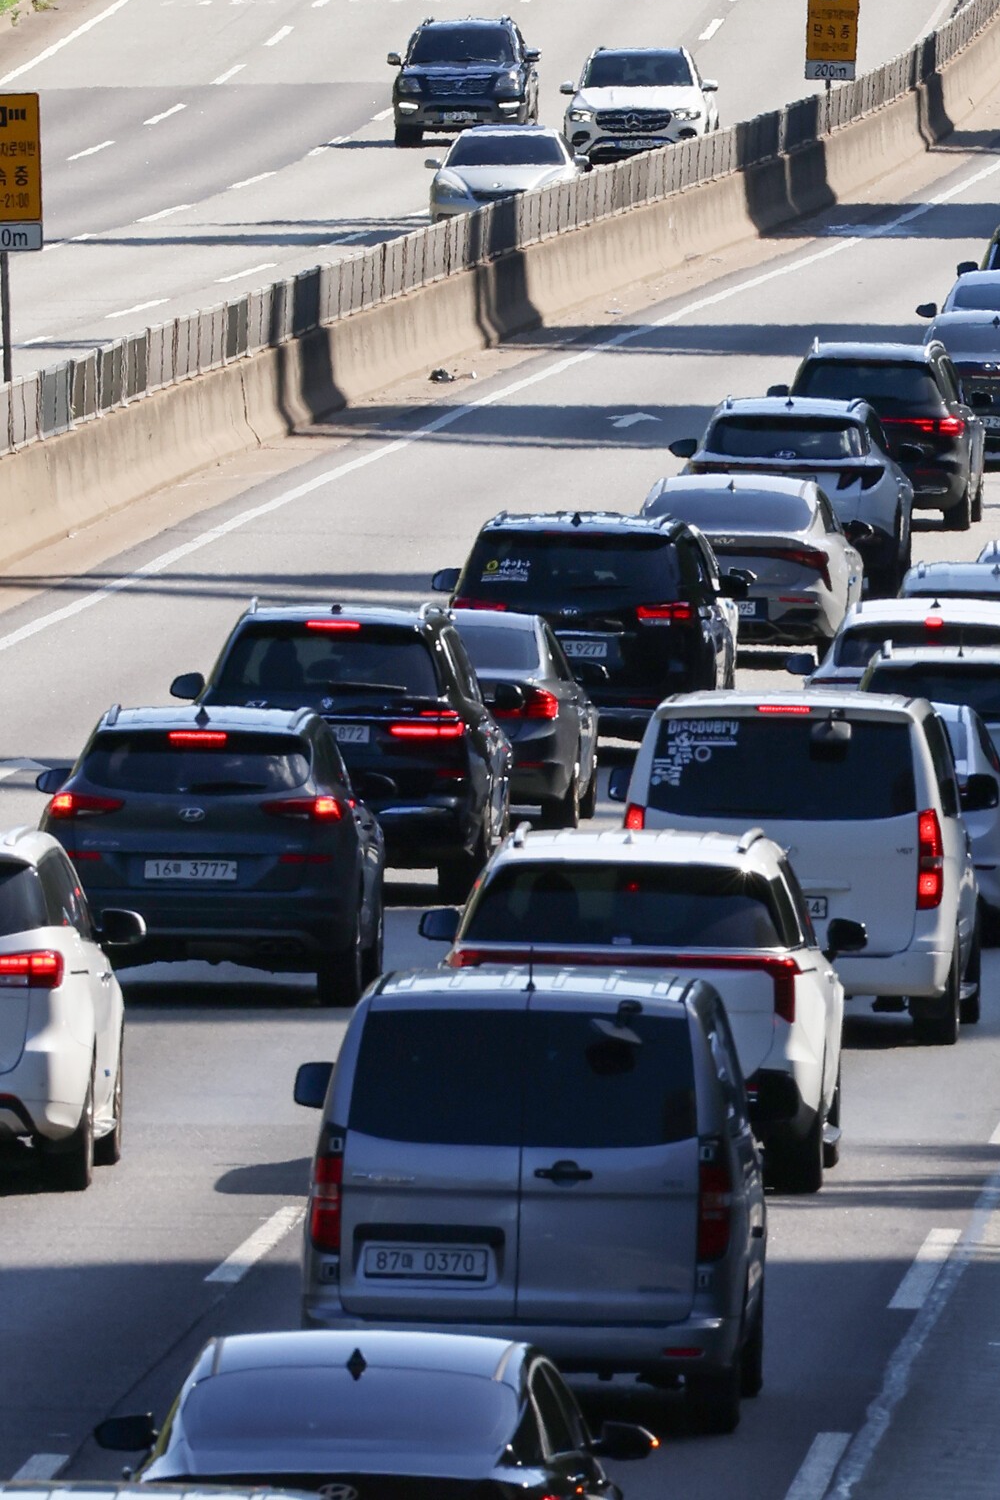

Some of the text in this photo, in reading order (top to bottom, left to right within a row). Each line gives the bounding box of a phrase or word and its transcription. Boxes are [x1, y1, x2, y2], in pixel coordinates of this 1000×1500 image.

[814, 64, 848, 78] 200m
[577, 643, 604, 655] 9277
[189, 862, 229, 877] 3777
[424, 1252, 475, 1273] 0370
